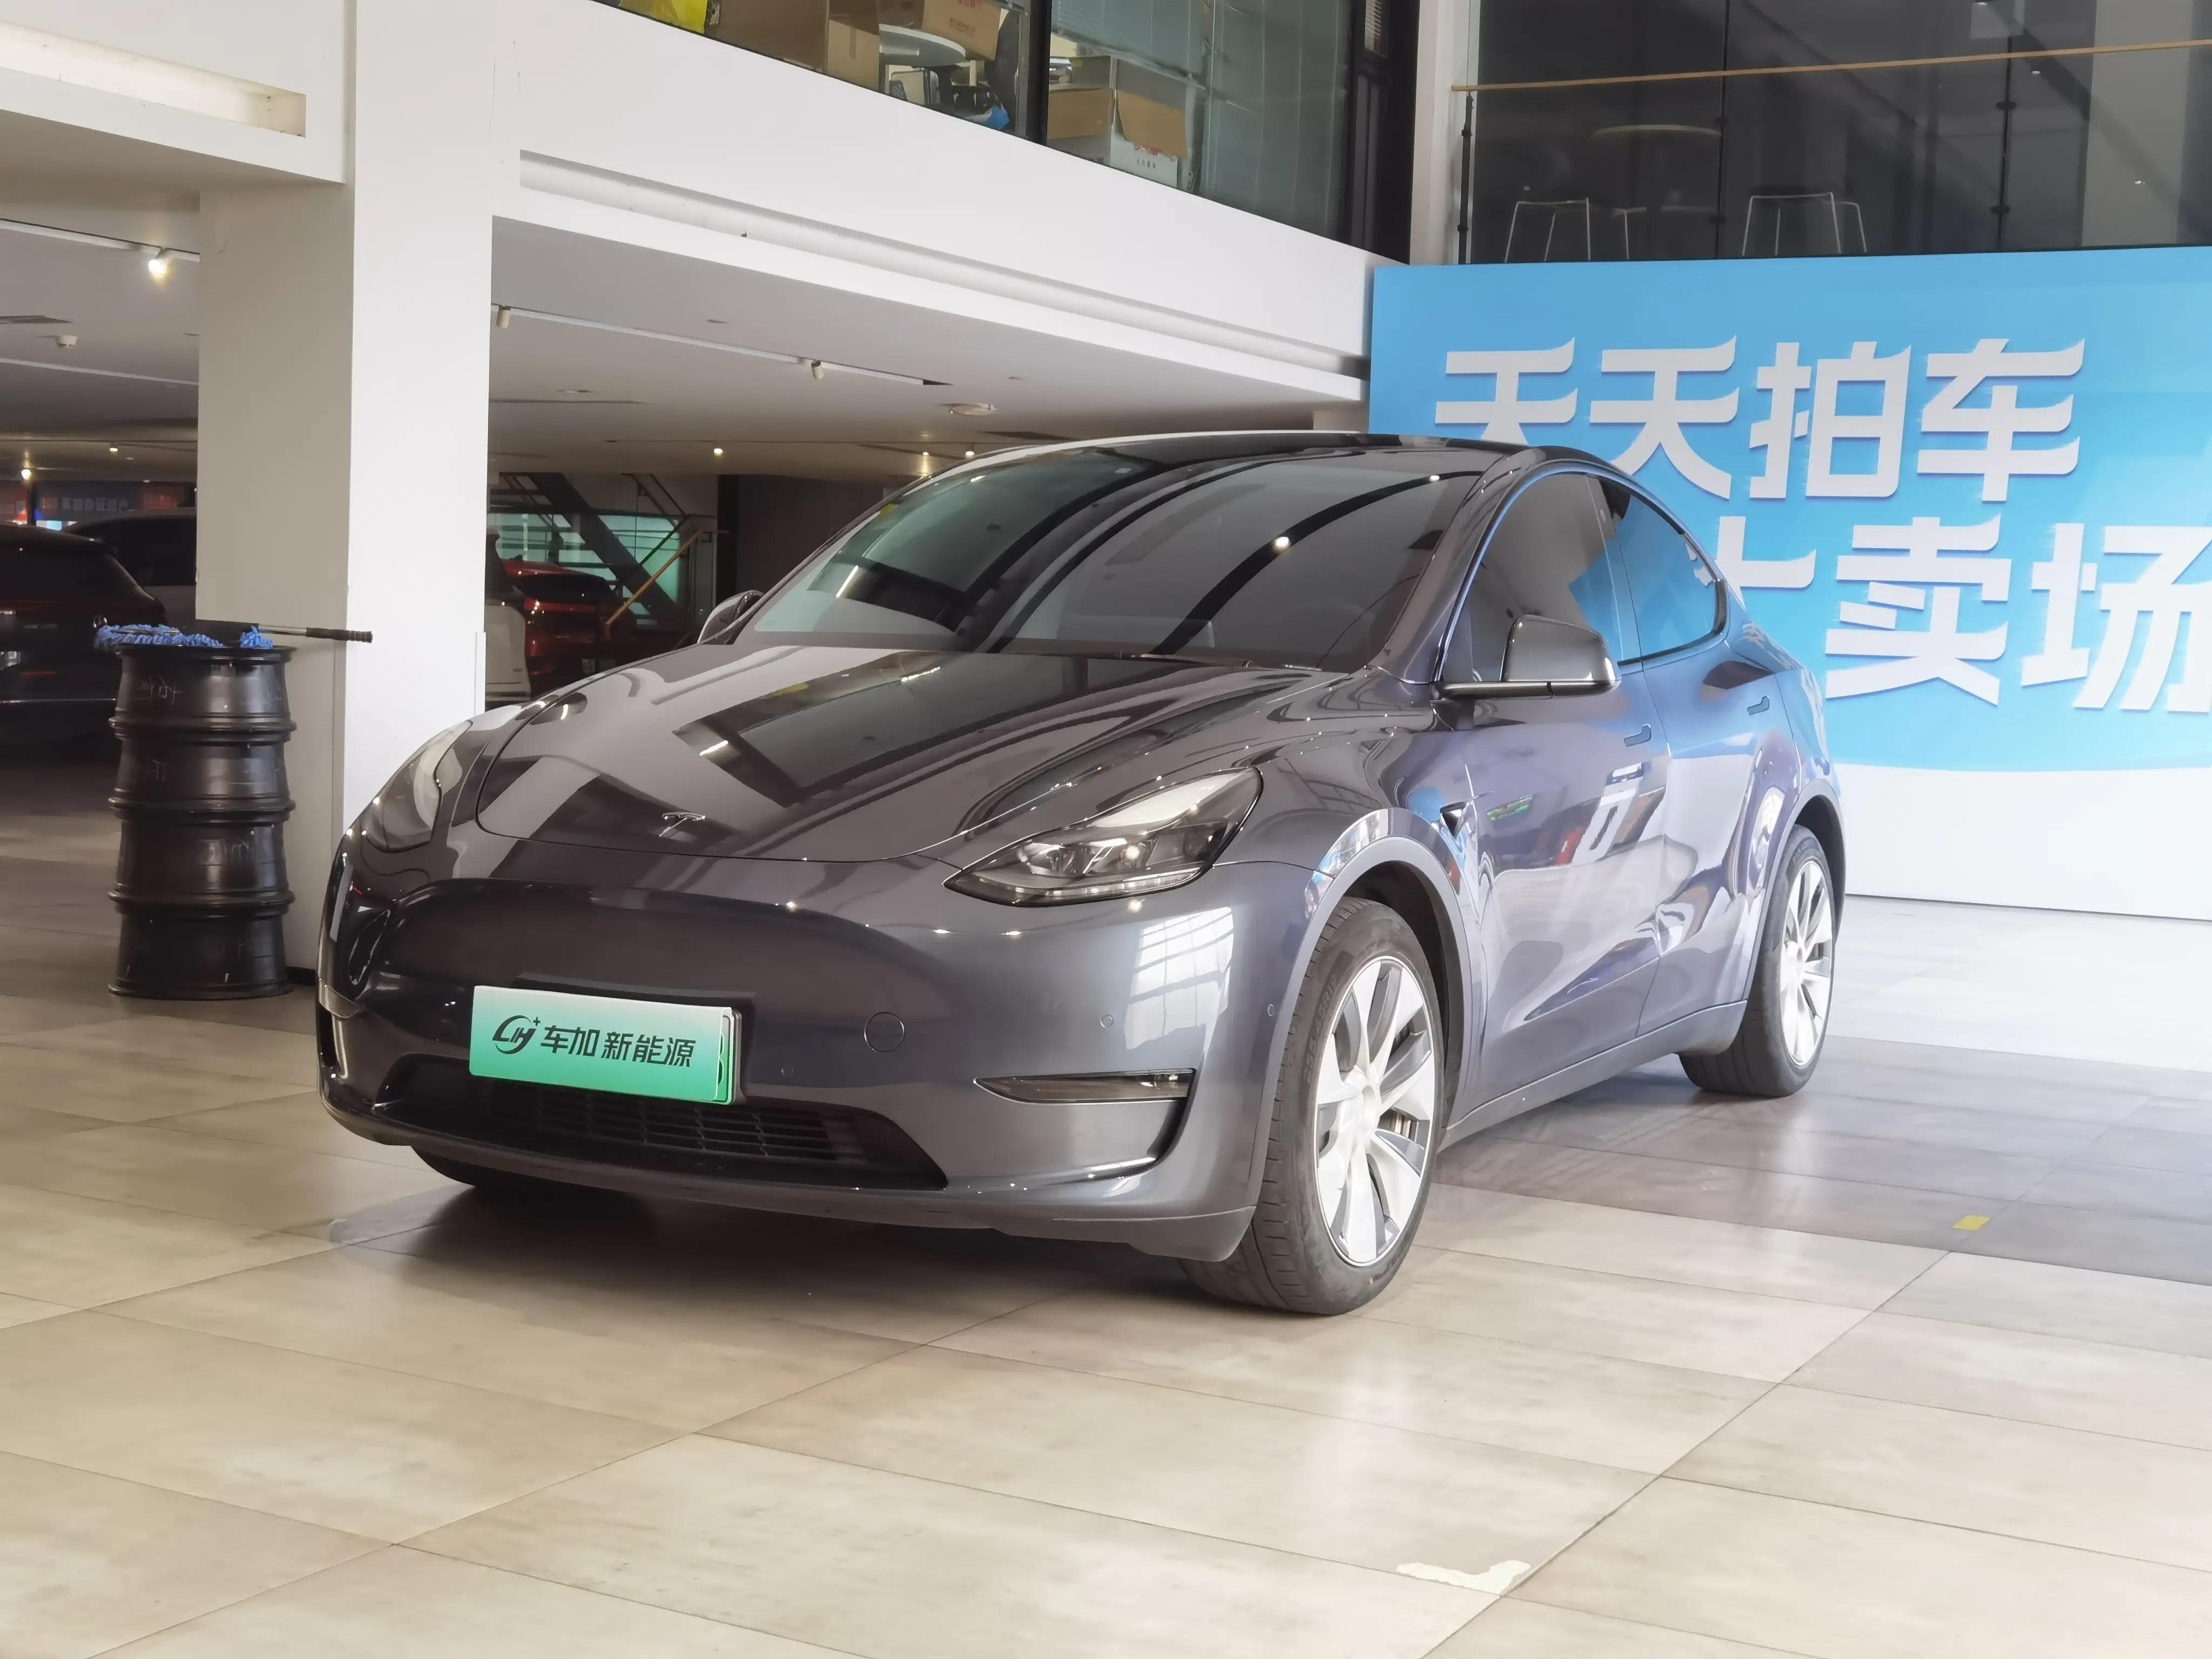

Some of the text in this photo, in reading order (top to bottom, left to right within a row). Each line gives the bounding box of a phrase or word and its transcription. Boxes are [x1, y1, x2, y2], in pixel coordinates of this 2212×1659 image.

[1434, 335, 2085, 502] 天天拍车
[540, 1025, 696, 1067] 车加新能源
